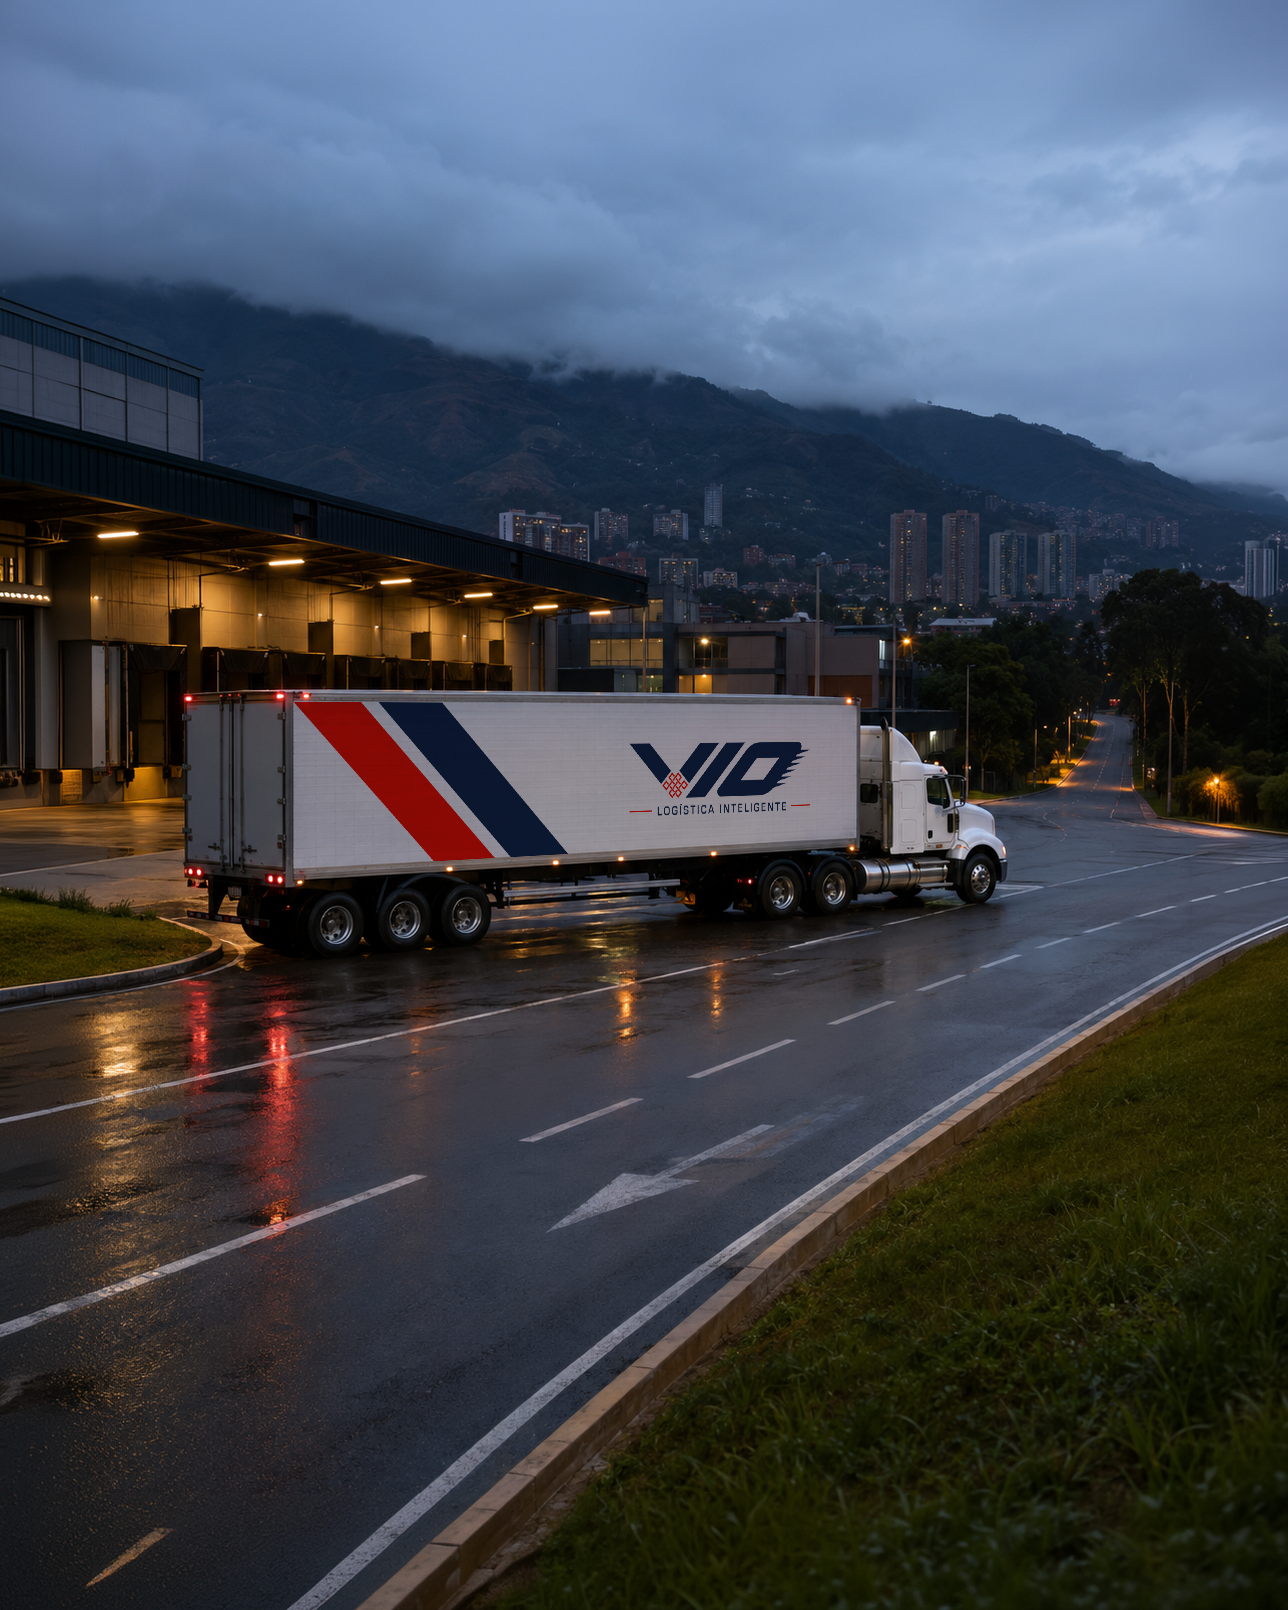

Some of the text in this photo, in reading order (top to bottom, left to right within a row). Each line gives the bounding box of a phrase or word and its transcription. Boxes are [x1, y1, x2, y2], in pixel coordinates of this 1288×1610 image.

[630, 742, 809, 798] VIO
[657, 801, 787, 816] LOGÍSTICA INTELIGENTE
